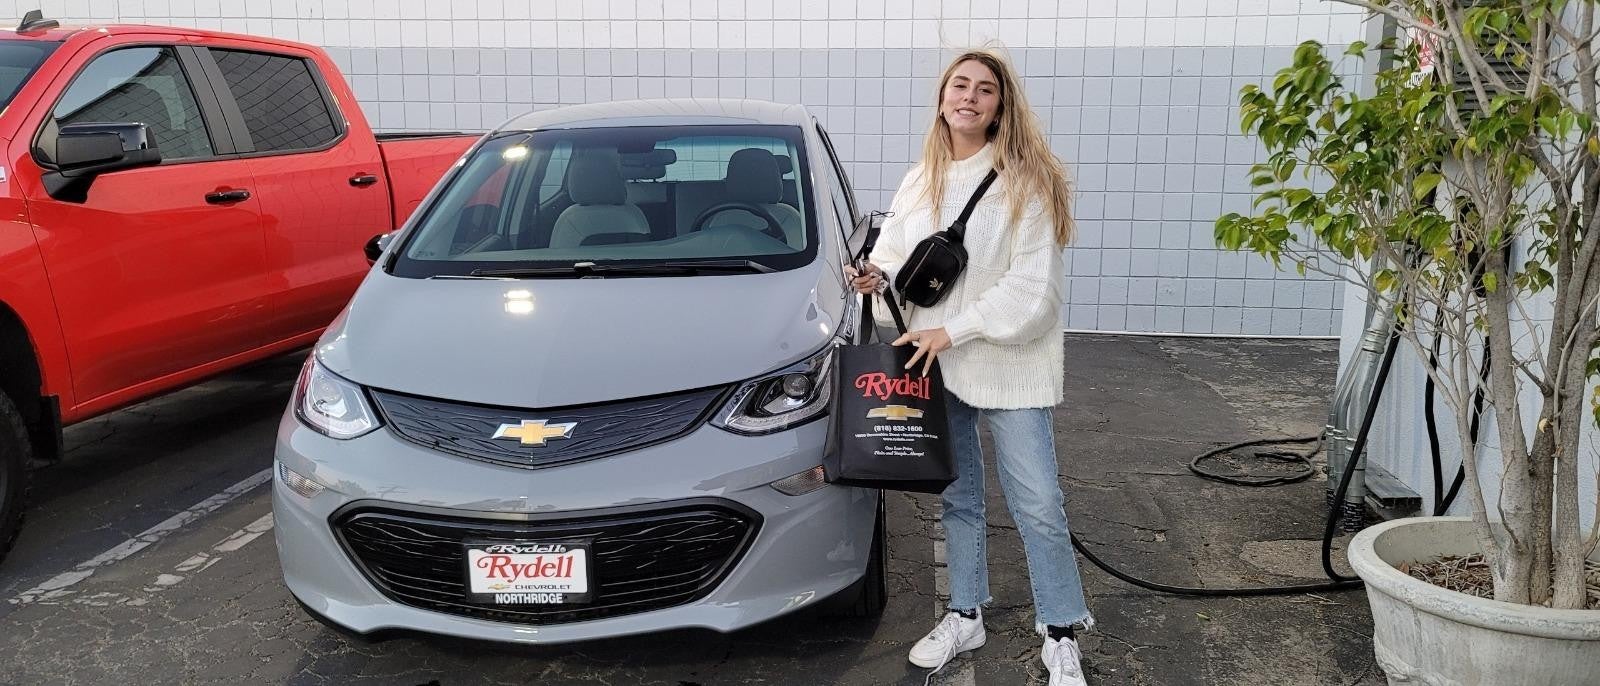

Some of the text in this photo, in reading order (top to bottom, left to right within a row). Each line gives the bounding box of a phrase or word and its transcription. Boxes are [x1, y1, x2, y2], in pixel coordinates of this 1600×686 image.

[855, 372, 930, 401] Rydell
[490, 544, 561, 554] Rydell
[477, 555, 574, 583] Rydell
[495, 593, 563, 604] NORTHRIDGE
